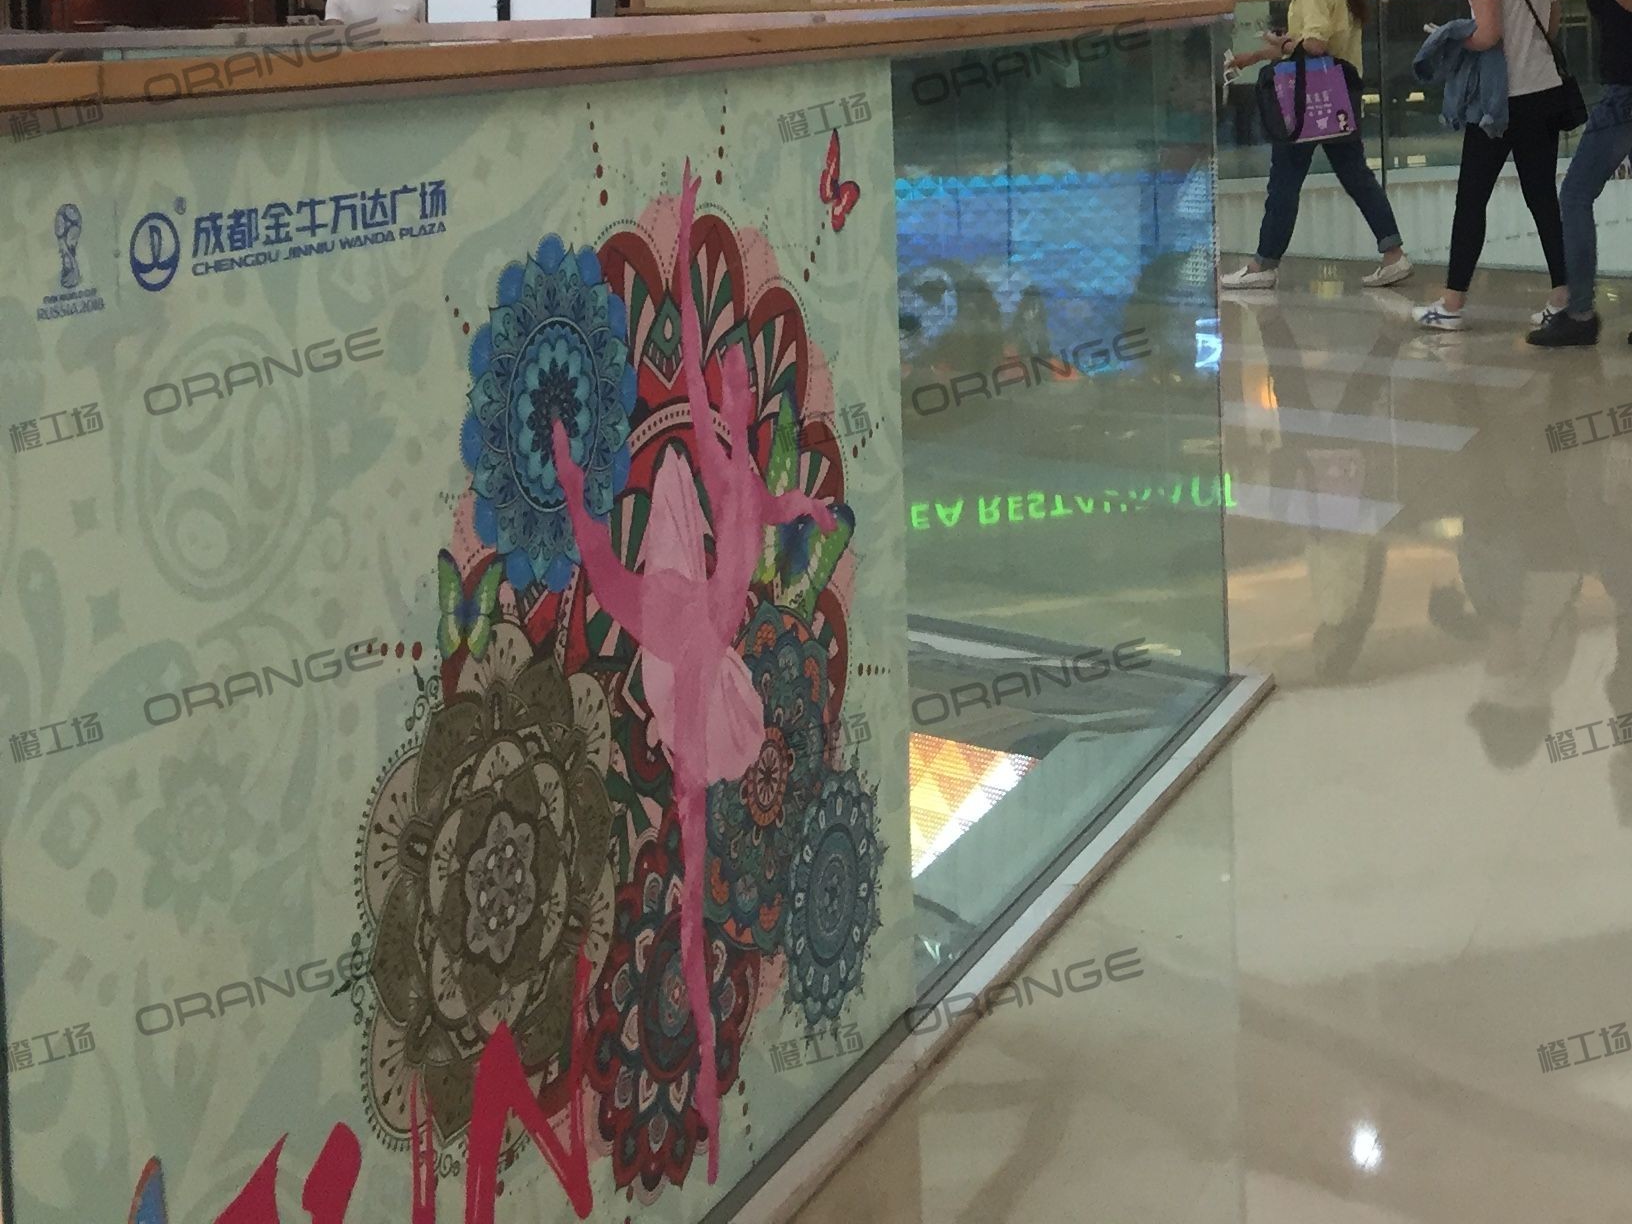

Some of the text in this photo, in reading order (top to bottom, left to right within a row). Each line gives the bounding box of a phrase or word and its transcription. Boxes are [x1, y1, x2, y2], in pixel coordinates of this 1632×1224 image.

[191, 220, 447, 277] CHENGDU JINNIU WANDA PLAZA
[192, 179, 448, 258] 成都金牛万达广场
